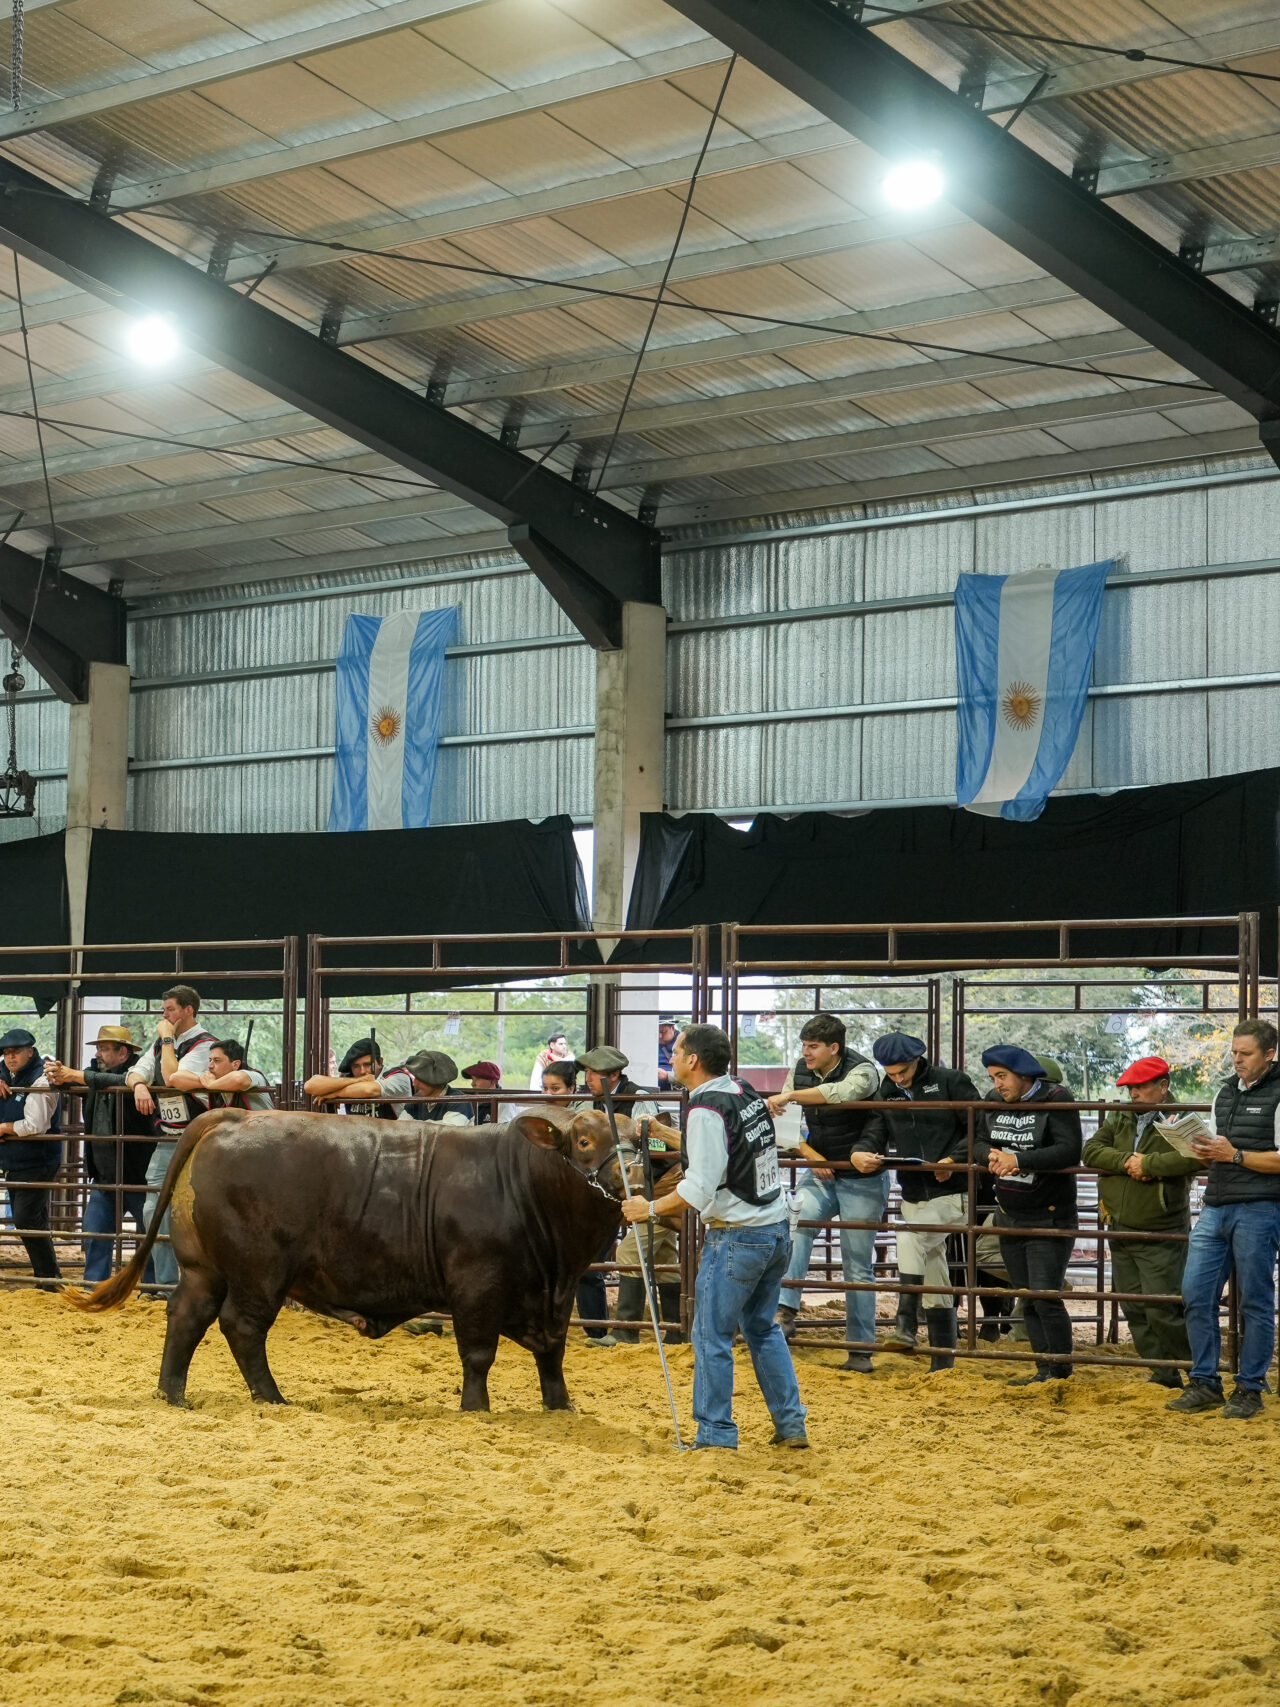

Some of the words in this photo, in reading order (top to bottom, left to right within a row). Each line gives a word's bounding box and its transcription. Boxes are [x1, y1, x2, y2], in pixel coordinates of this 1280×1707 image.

[162, 1107, 181, 1120] 303
[996, 1114, 1036, 1129] BRANGUS
[990, 1130, 1034, 1141] BIOZECTRA
[760, 1166, 777, 1190] 316
